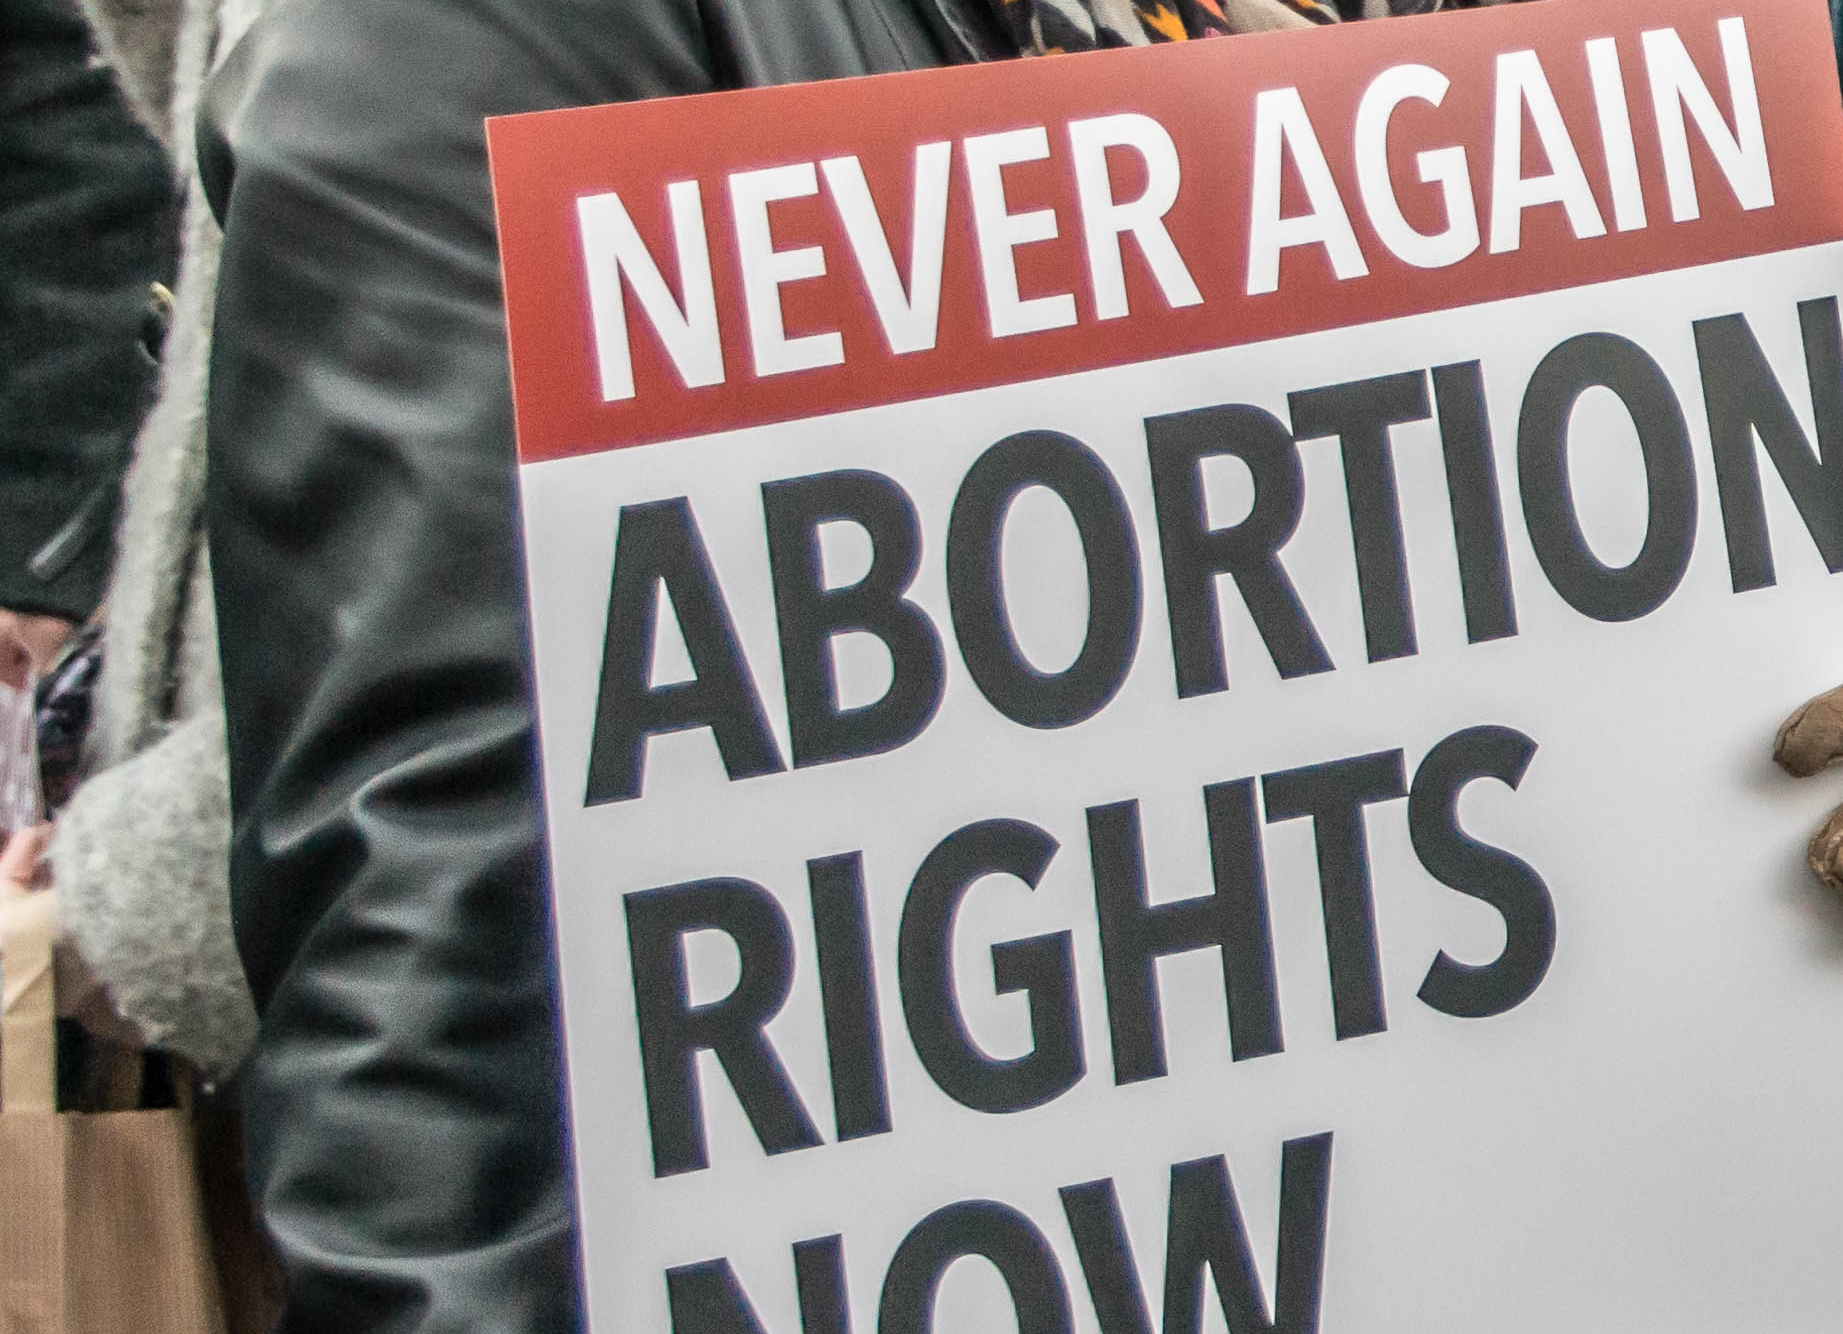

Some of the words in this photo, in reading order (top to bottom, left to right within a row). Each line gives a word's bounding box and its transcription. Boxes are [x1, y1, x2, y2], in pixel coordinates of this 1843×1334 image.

[574, 109, 1206, 404] NEVER
[1245, 17, 1776, 297] AGAIN
[621, 723, 1558, 1179] RIGHTS
